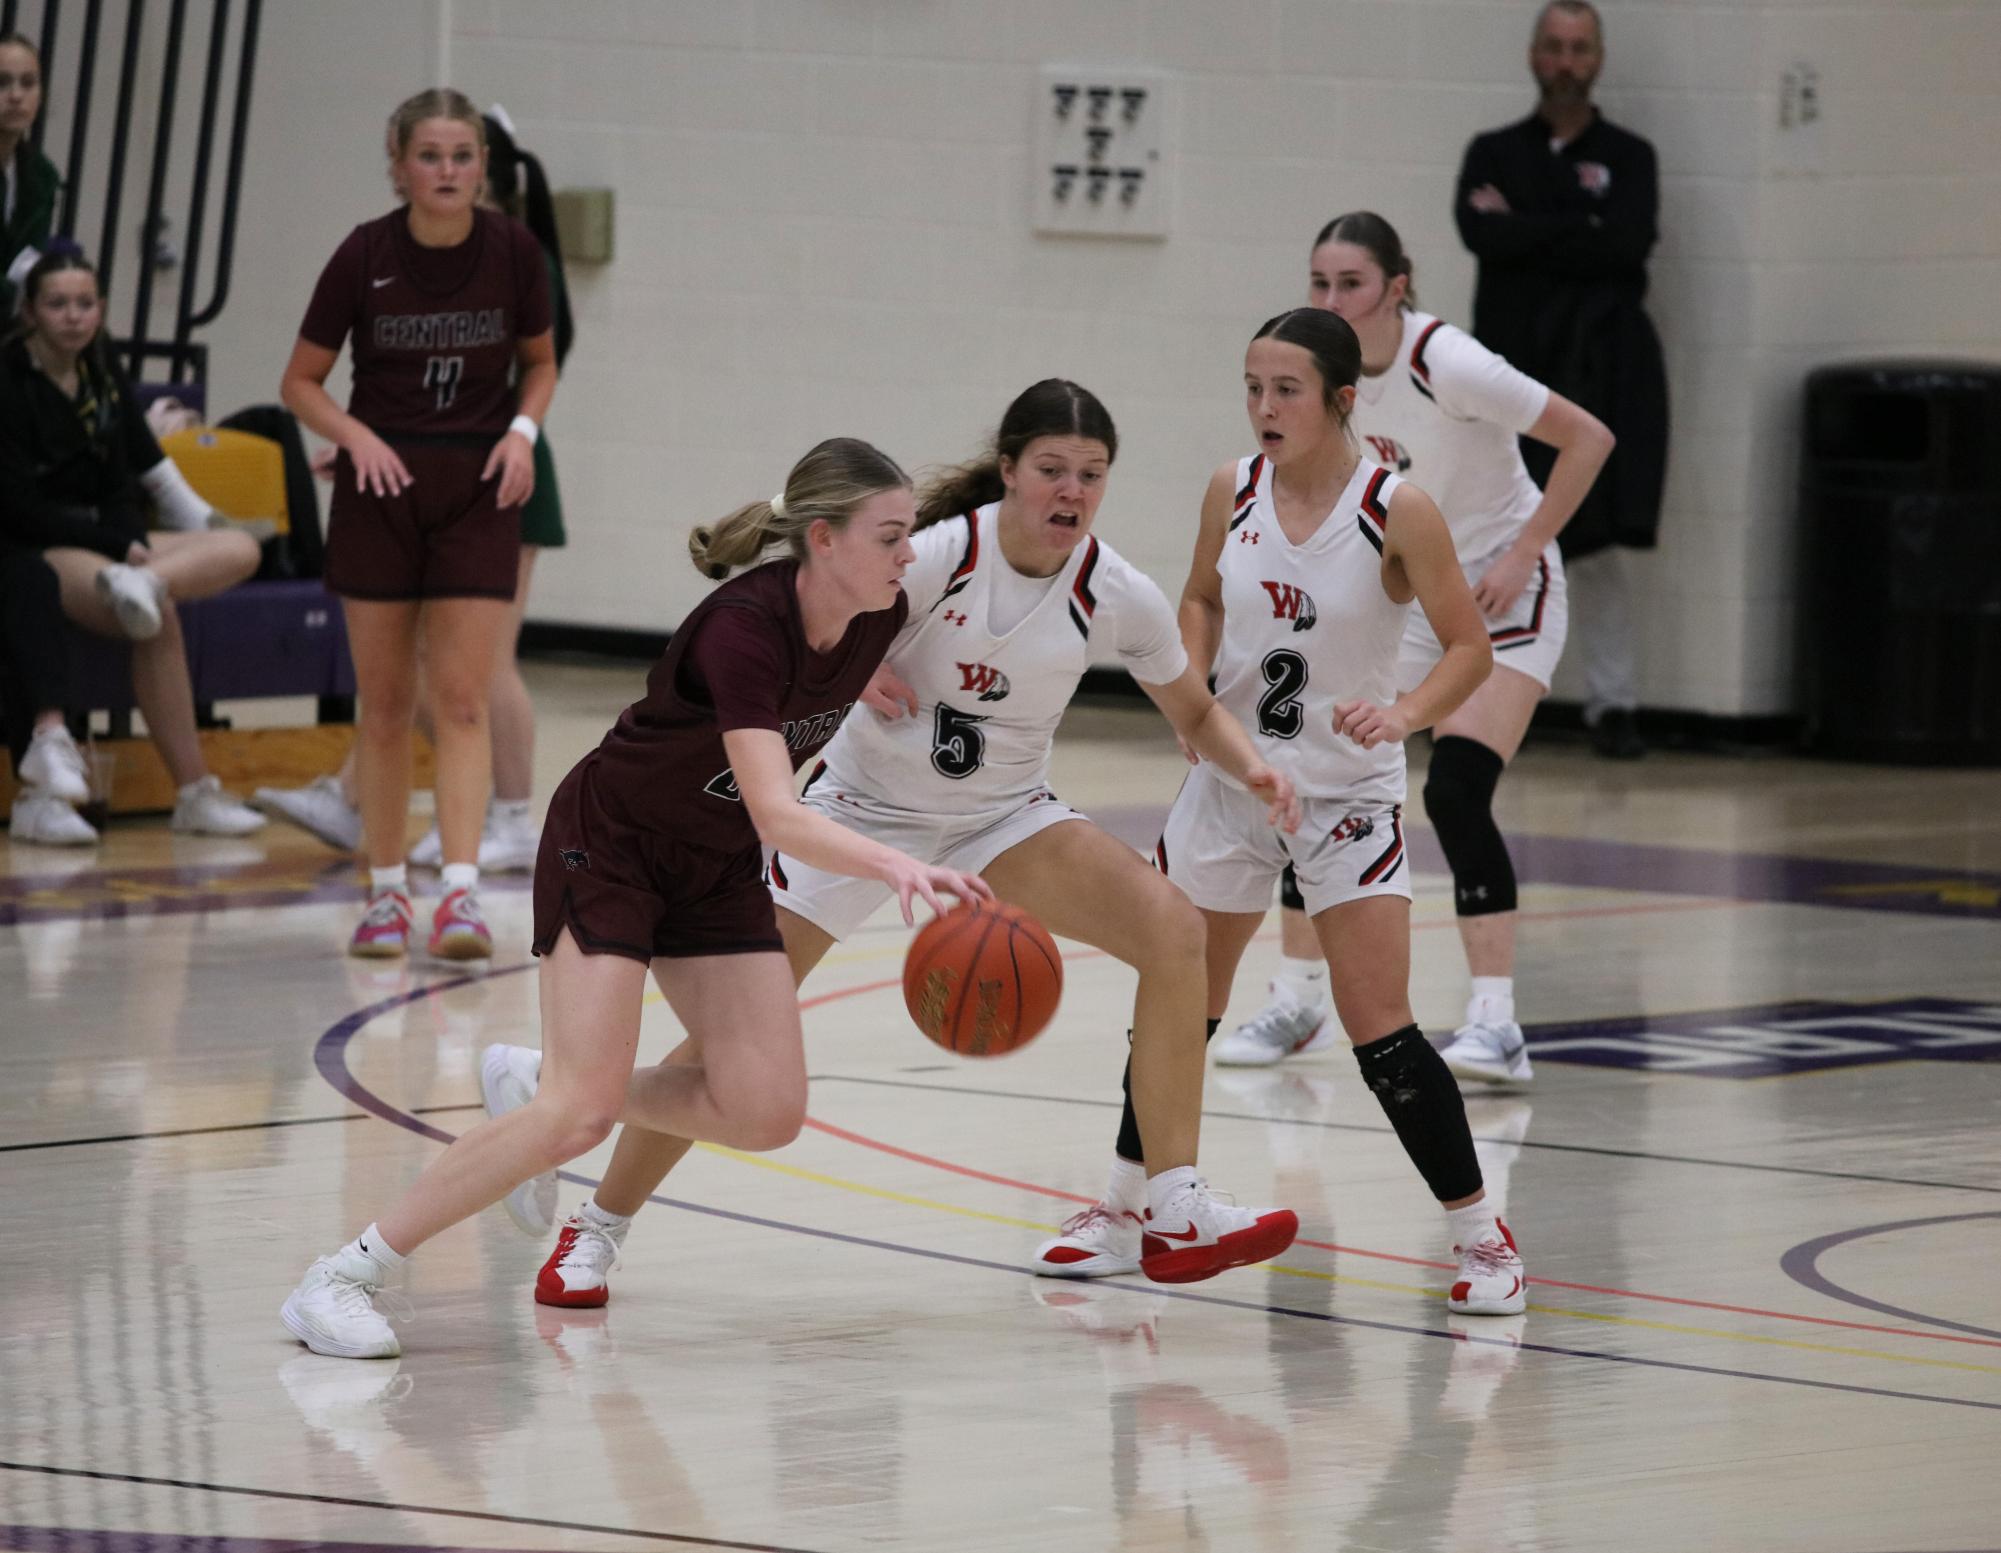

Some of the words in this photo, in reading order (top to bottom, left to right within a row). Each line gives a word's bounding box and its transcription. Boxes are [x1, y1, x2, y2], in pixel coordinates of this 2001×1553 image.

[373, 308, 505, 349] CENTRAL
[1259, 580, 1302, 621] W
[955, 662, 999, 694] W
[1256, 648, 1309, 740] 2
[930, 700, 990, 780] 5
